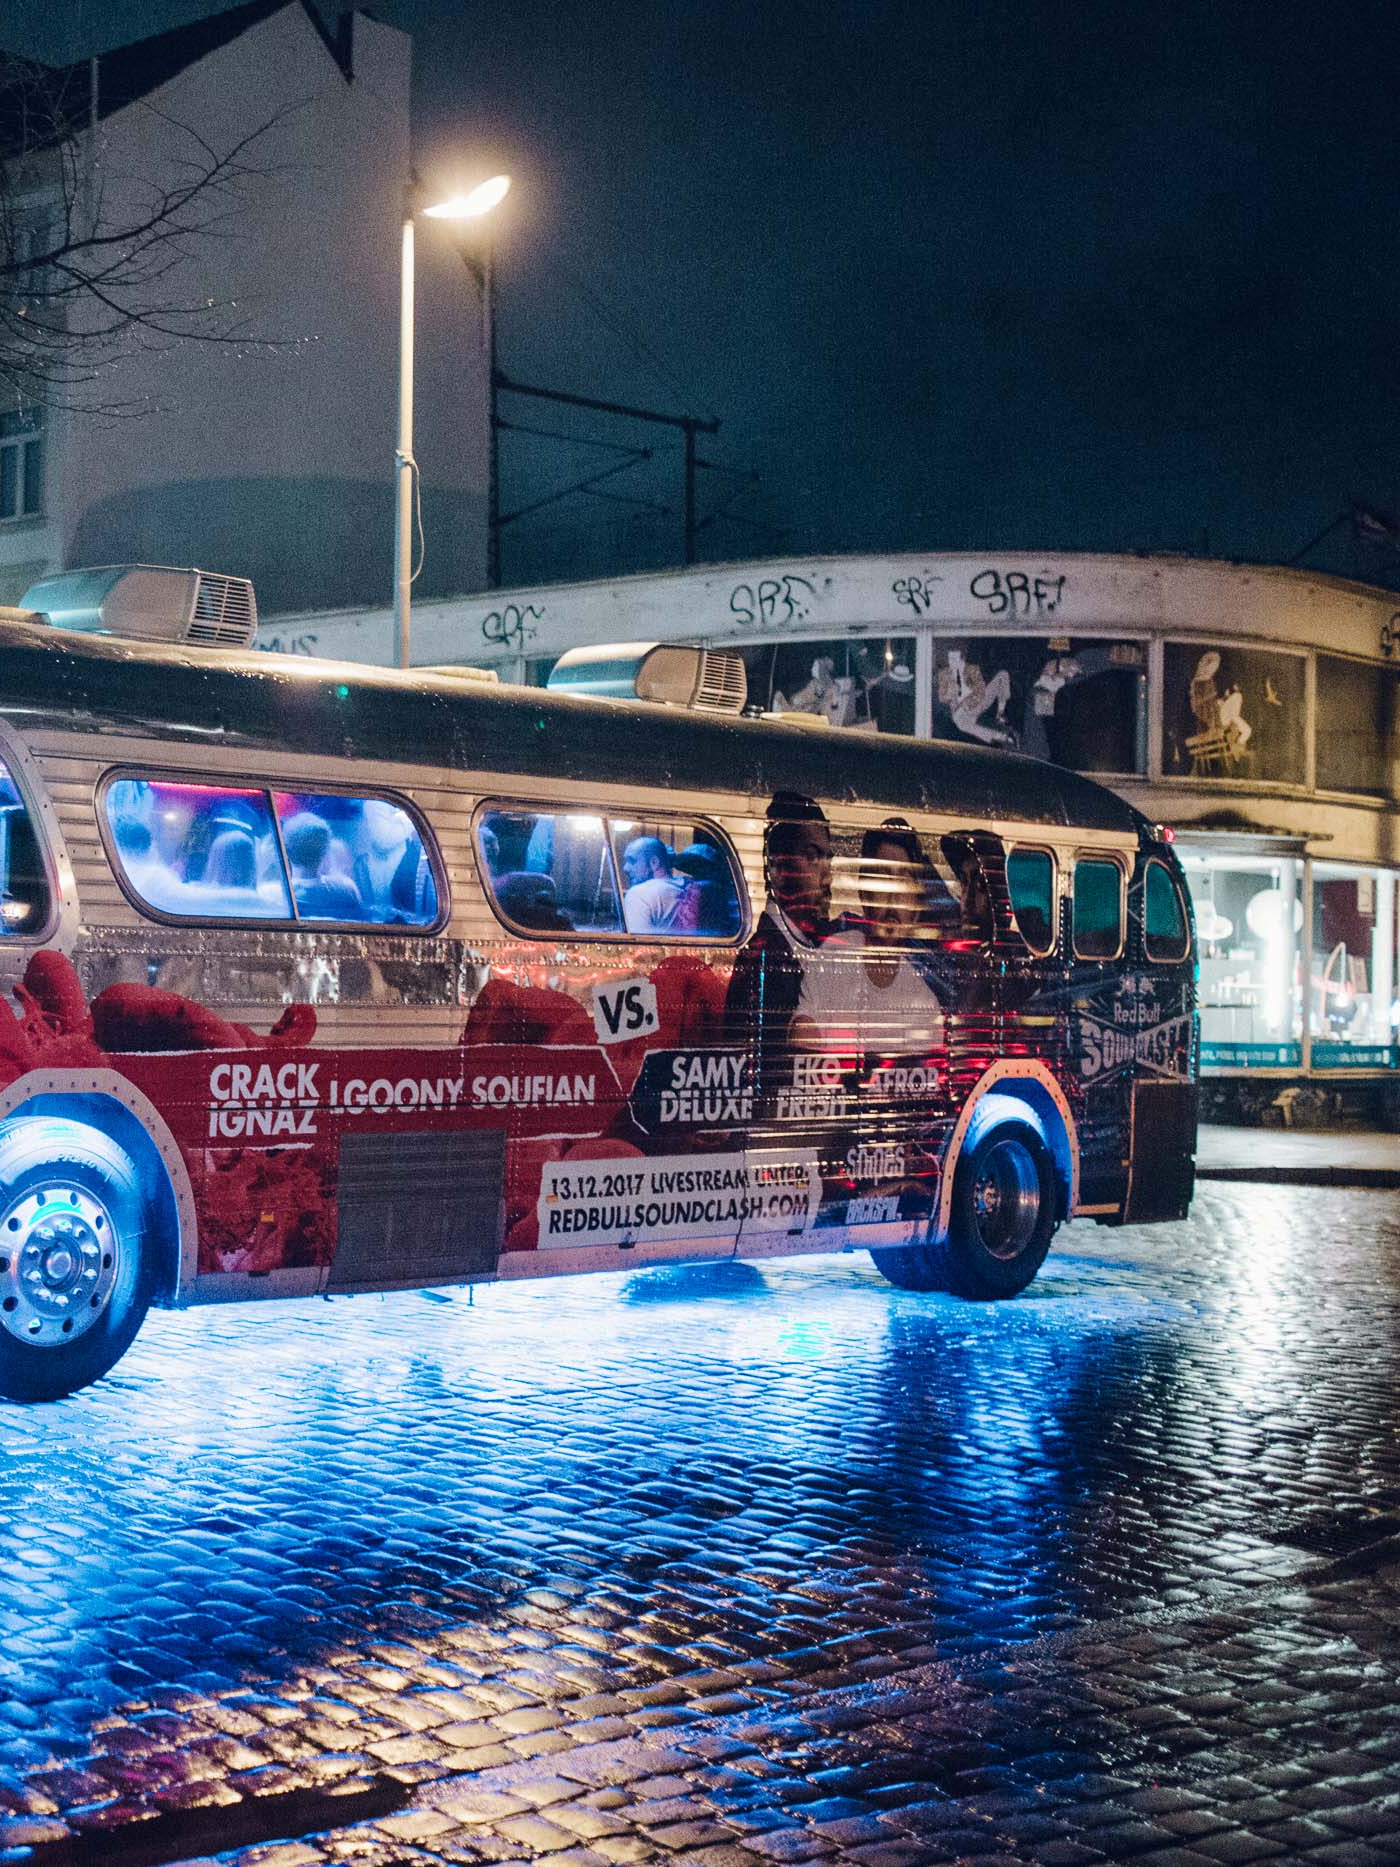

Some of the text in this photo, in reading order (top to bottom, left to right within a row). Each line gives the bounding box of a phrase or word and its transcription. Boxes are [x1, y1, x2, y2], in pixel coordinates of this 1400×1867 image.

[598, 986, 654, 1035] VS.
[1114, 1001, 1161, 1023] Red Bull
[209, 1063, 320, 1100] CRACK
[671, 1056, 746, 1089] SAMY
[793, 1057, 841, 1087] EKO
[472, 1075, 596, 1109] SOUFIAN
[660, 1089, 753, 1122] DELUXE
[209, 1100, 319, 1137] IGNAZ
[551, 1173, 644, 1200] 13.12.2017
[651, 1169, 749, 1194] LIVESTREAM
[549, 1194, 809, 1234] REDBULLSOUNDCLASH.COM
